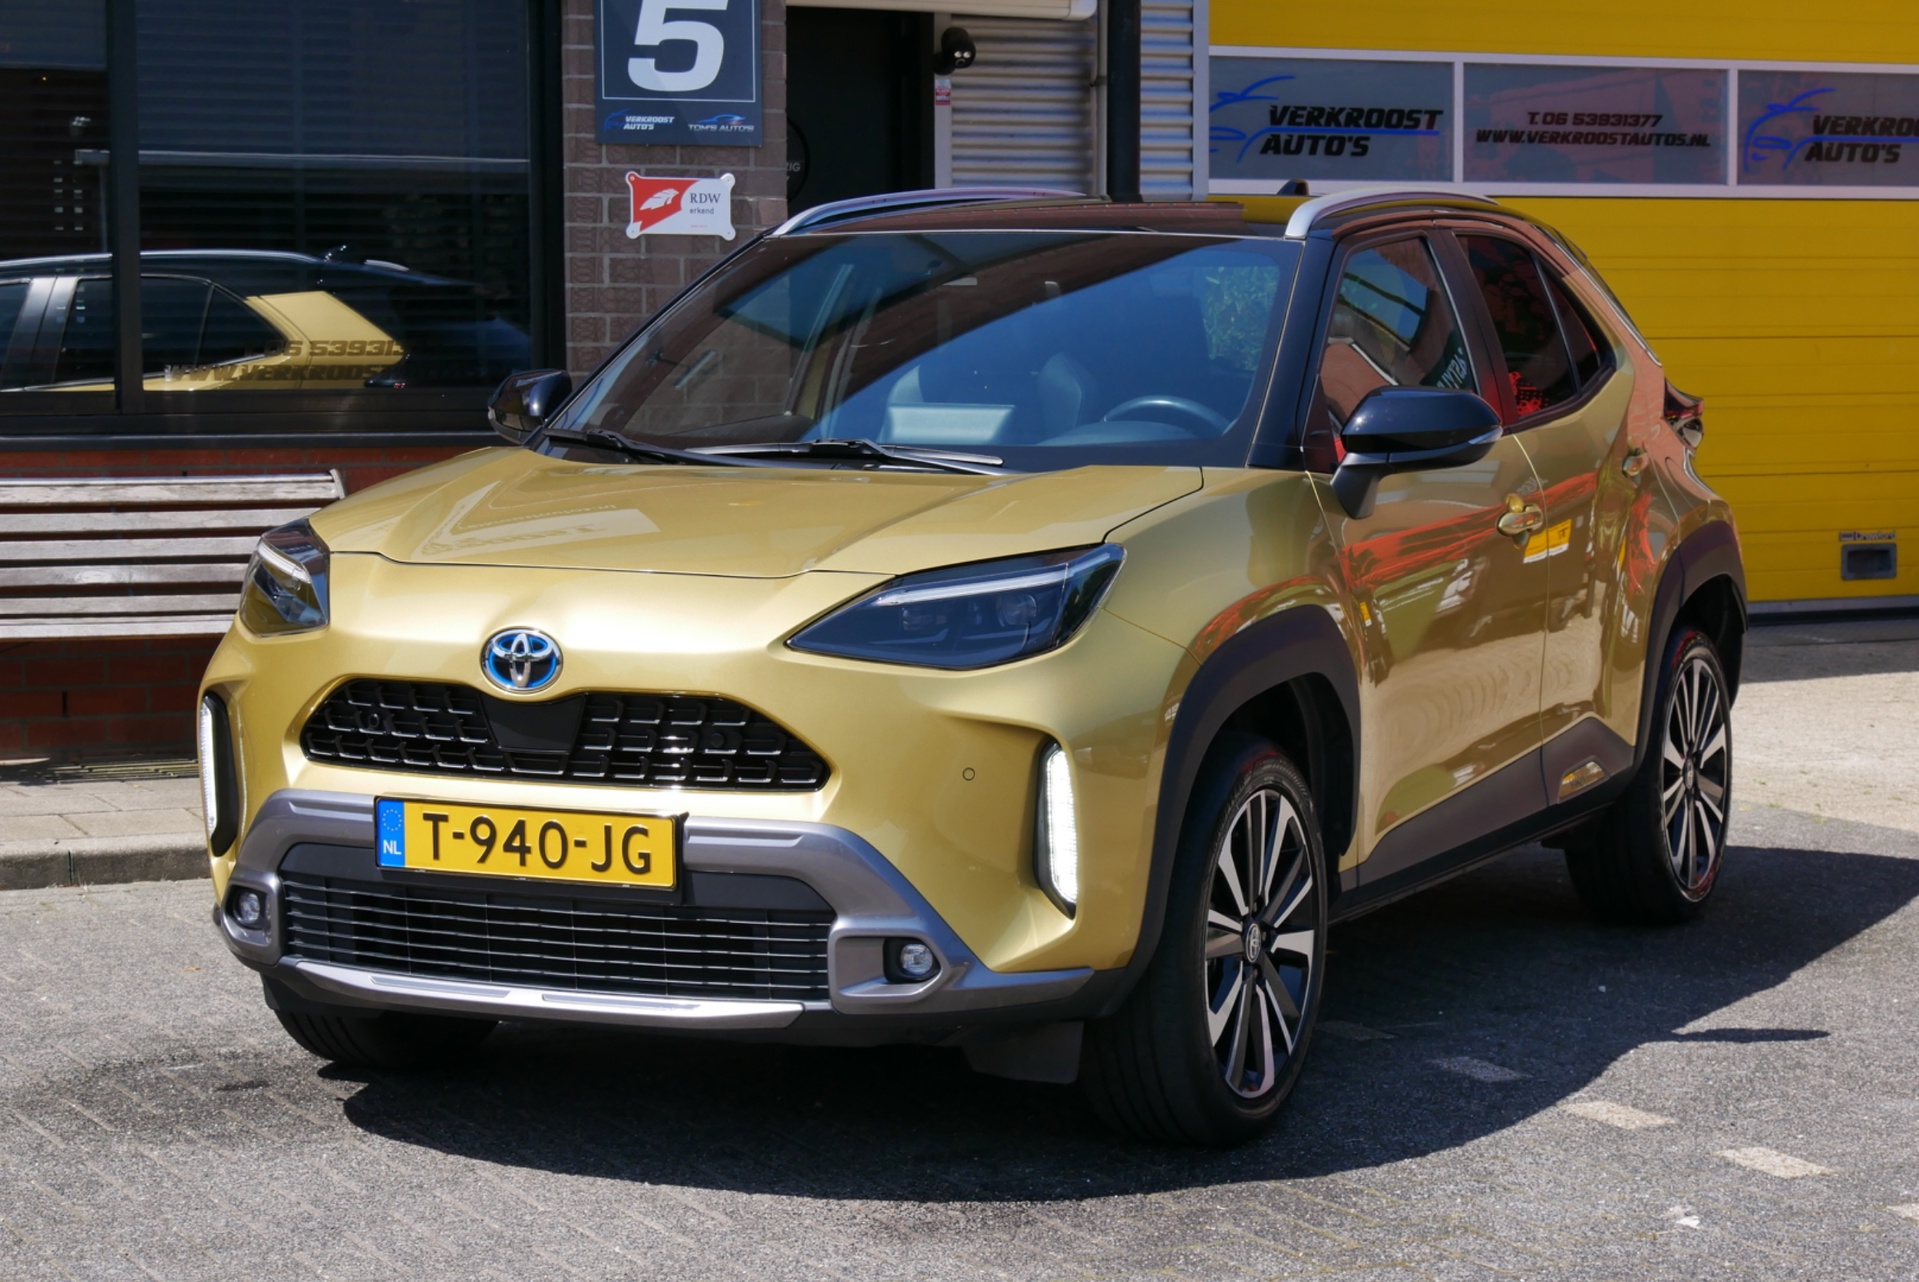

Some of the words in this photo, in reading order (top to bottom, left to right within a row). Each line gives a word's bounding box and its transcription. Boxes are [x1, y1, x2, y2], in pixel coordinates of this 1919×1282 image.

[628, 0, 728, 92] 5
[625, 115, 675, 123] VERKROOST
[1268, 105, 1443, 130] VERKROOST
[1542, 112, 1569, 126] 06
[1572, 113, 1663, 127] 53931377
[623, 123, 654, 131] AUTO'S
[1259, 133, 1371, 157] AUTO'S
[1476, 129, 1711, 147] WWW.VERKROOSTAUTOS.NL
[1804, 141, 1902, 164] AUTO'S
[690, 193, 721, 204] RDW
[689, 207, 714, 215] erkend
[383, 839, 402, 855] NL
[422, 811, 652, 875] T-940-JG
